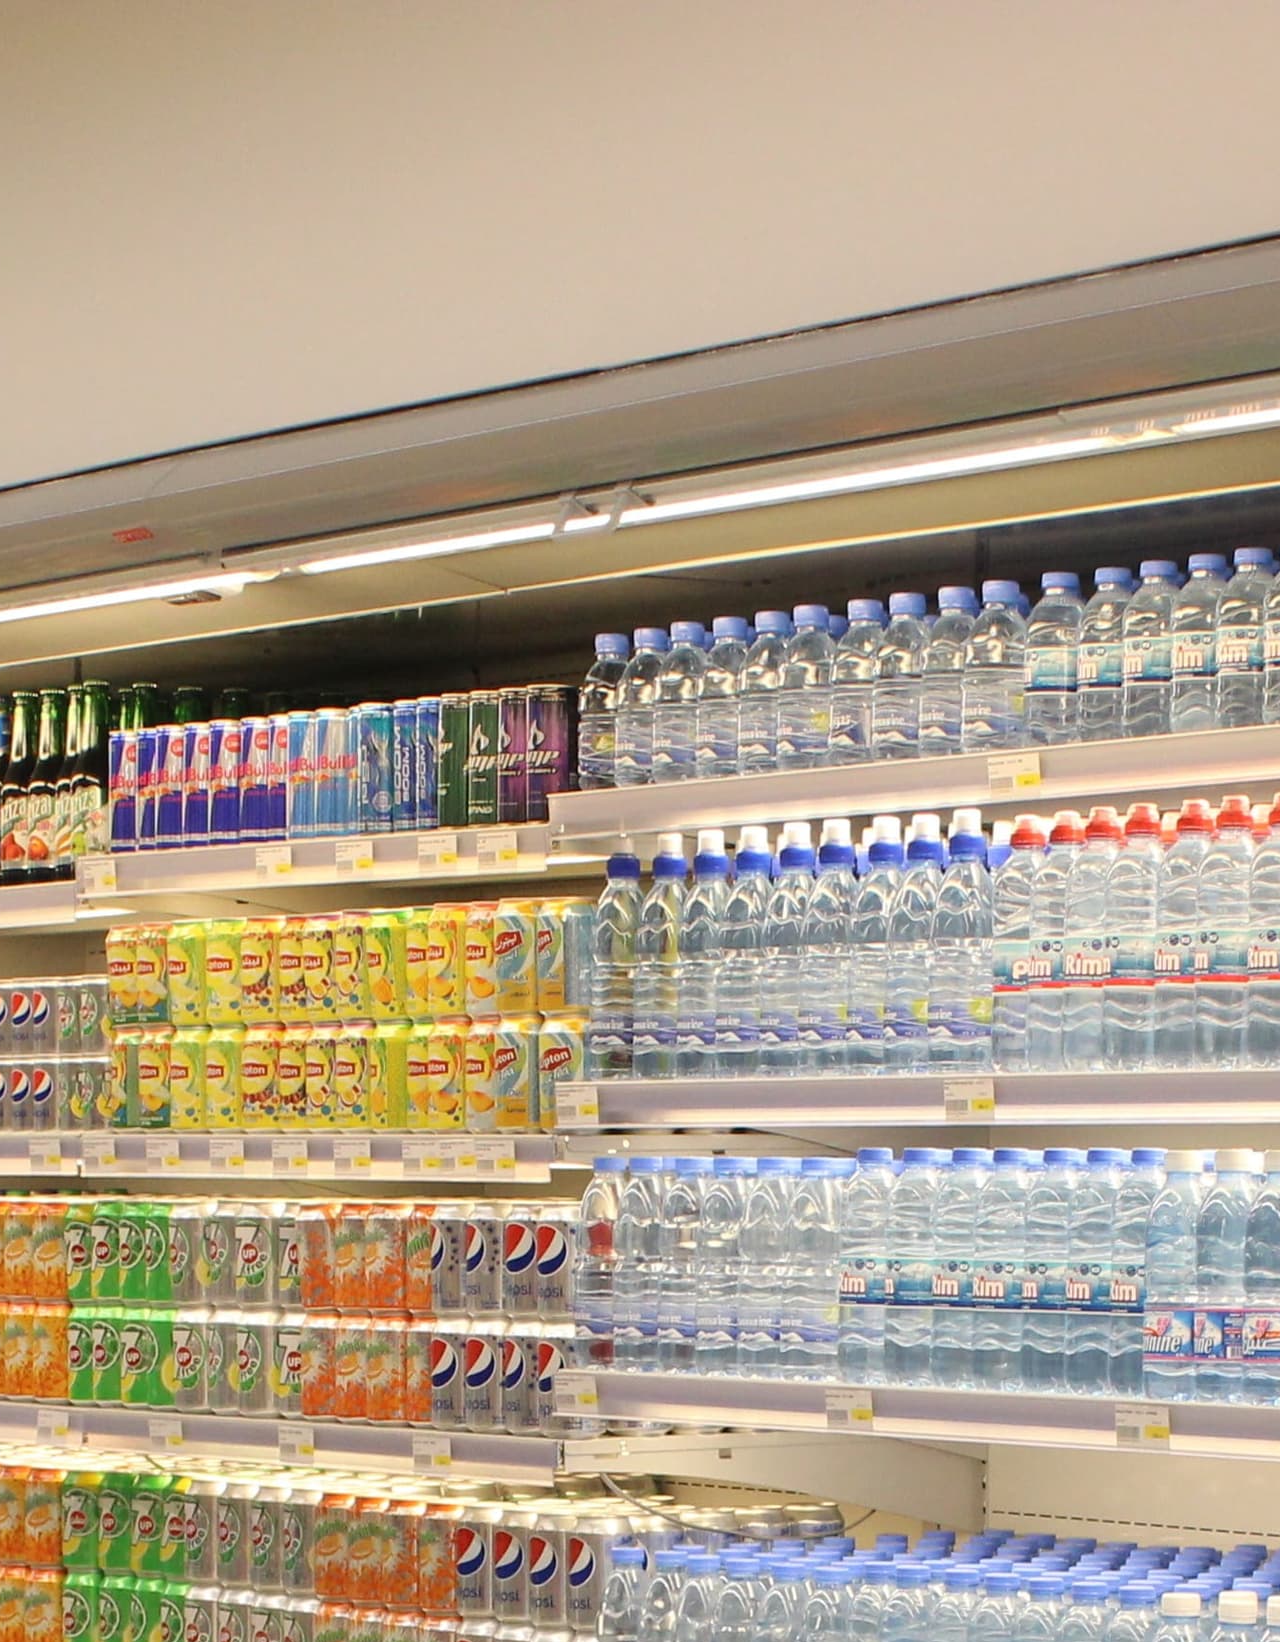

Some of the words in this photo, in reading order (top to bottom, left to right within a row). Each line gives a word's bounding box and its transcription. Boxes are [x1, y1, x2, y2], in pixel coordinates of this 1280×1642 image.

[1175, 645, 1204, 669] im
[1220, 644, 1249, 664] im
[207, 960, 231, 972] pton
[1029, 955, 1052, 979] im
[1066, 952, 1103, 976] Rim
[242, 1065, 266, 1078] pton
[432, 1399, 455, 1412] psi
